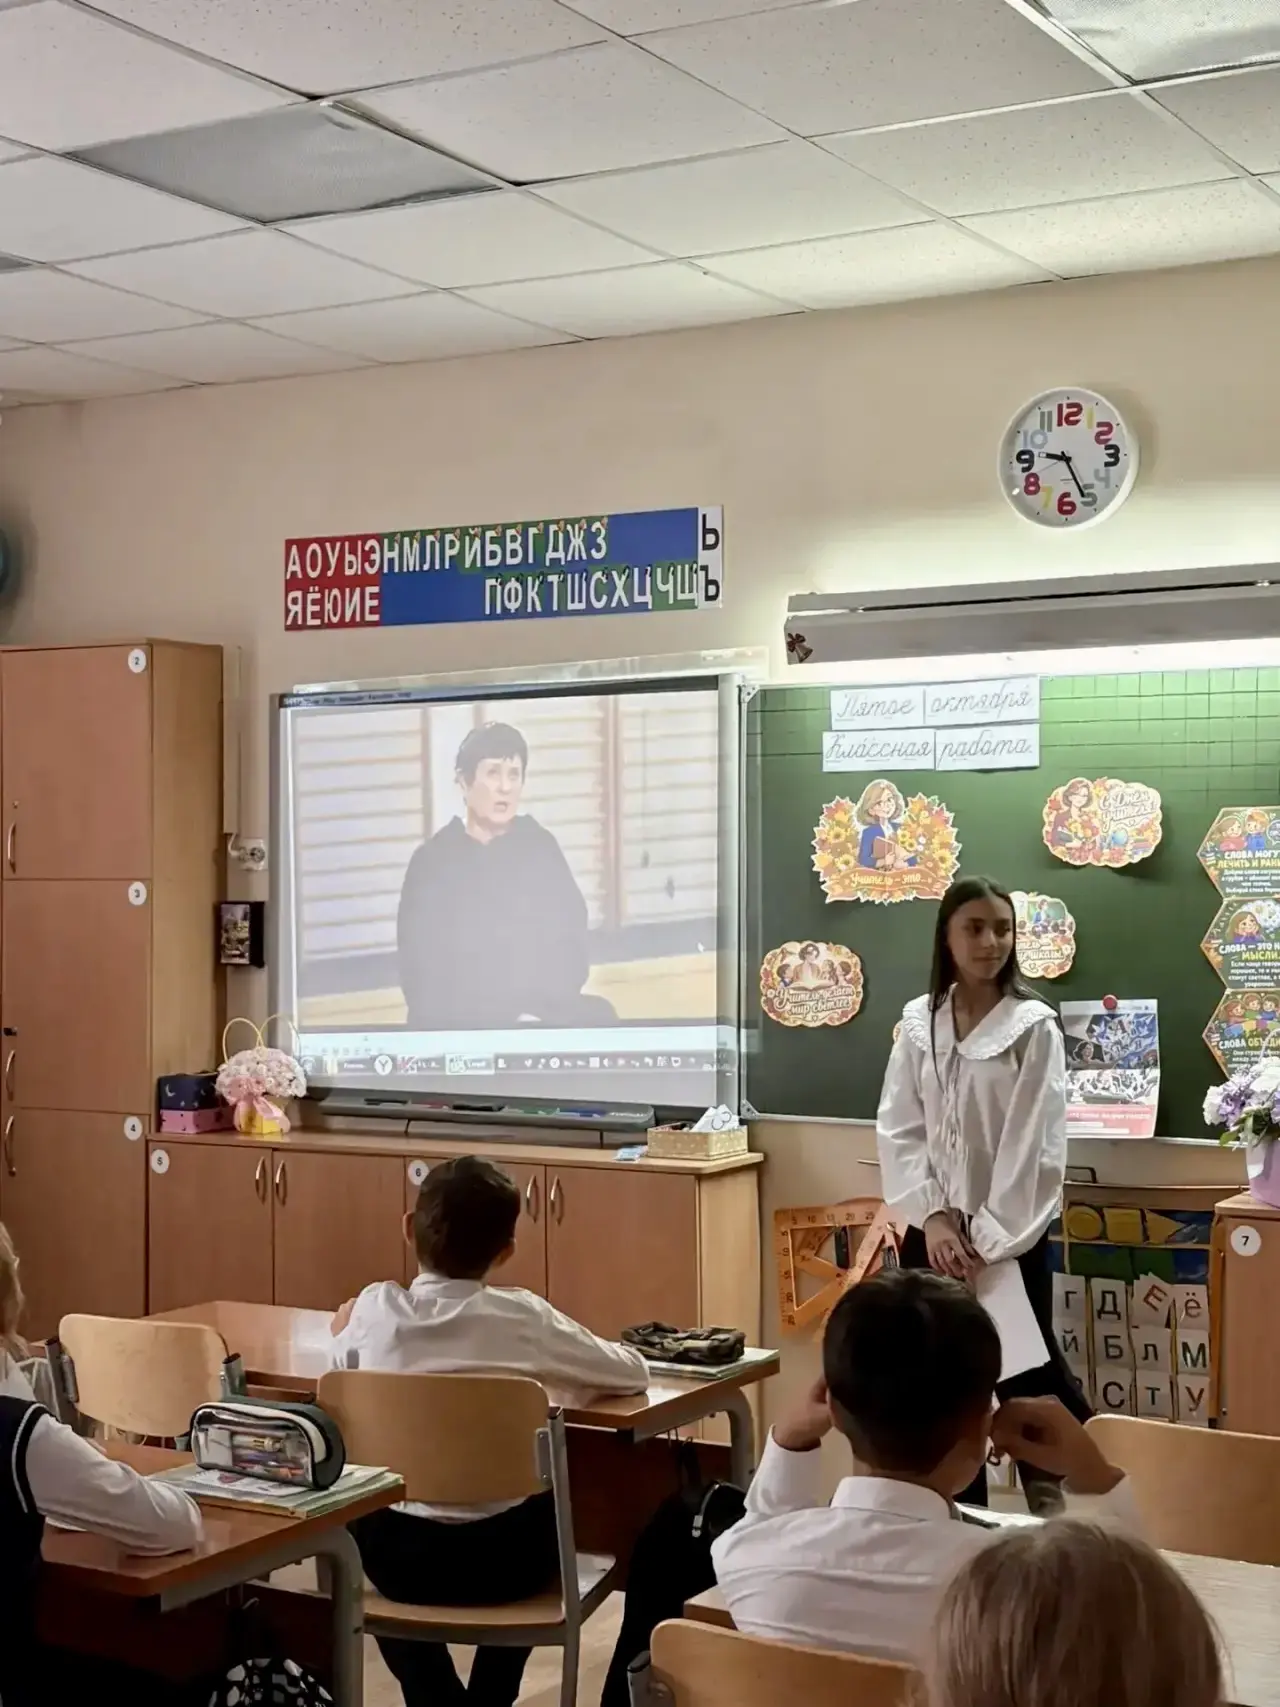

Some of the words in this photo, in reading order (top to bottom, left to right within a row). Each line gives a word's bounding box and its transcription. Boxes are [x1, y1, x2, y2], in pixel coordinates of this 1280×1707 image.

[1040, 411, 1053, 432] 11
[1057, 402, 1083, 427] 12
[1086, 407, 1094, 429] 1
[1022, 429, 1048, 449] 10
[1094, 421, 1113, 445] 2
[1016, 449, 1035, 473] 9
[1104, 444, 1120, 468] 3
[1024, 472, 1040, 495] 8
[1094, 468, 1110, 488] 4
[1041, 486, 1053, 509] 7
[1057, 492, 1077, 516] 6
[1080, 483, 1098, 507] 5
[134, 656, 141, 666] 2
[836, 694, 916, 718] Пятое
[930, 680, 1032, 718] октября
[825, 733, 932, 760] Классная
[1217, 859, 1250, 869] ЛЕЧИТЬ
[1252, 859, 1259, 868] И
[1224, 850, 1253, 860] СЛОВА
[850, 872, 894, 887] Учитель
[134, 889, 141, 898] 3
[1219, 944, 1247, 954] СЛОВА
[1256, 942, 1273, 951] ЭТО
[791, 1004, 811, 1018] мир
[1219, 1038, 1247, 1049] СЛОВА
[130, 1124, 136, 1132] 4
[156, 1156, 163, 1166] 5
[415, 1167, 421, 1177] 6
[1241, 1236, 1250, 1246] 7
[1096, 1290, 1122, 1321] Д
[1104, 1335, 1124, 1360] Б
